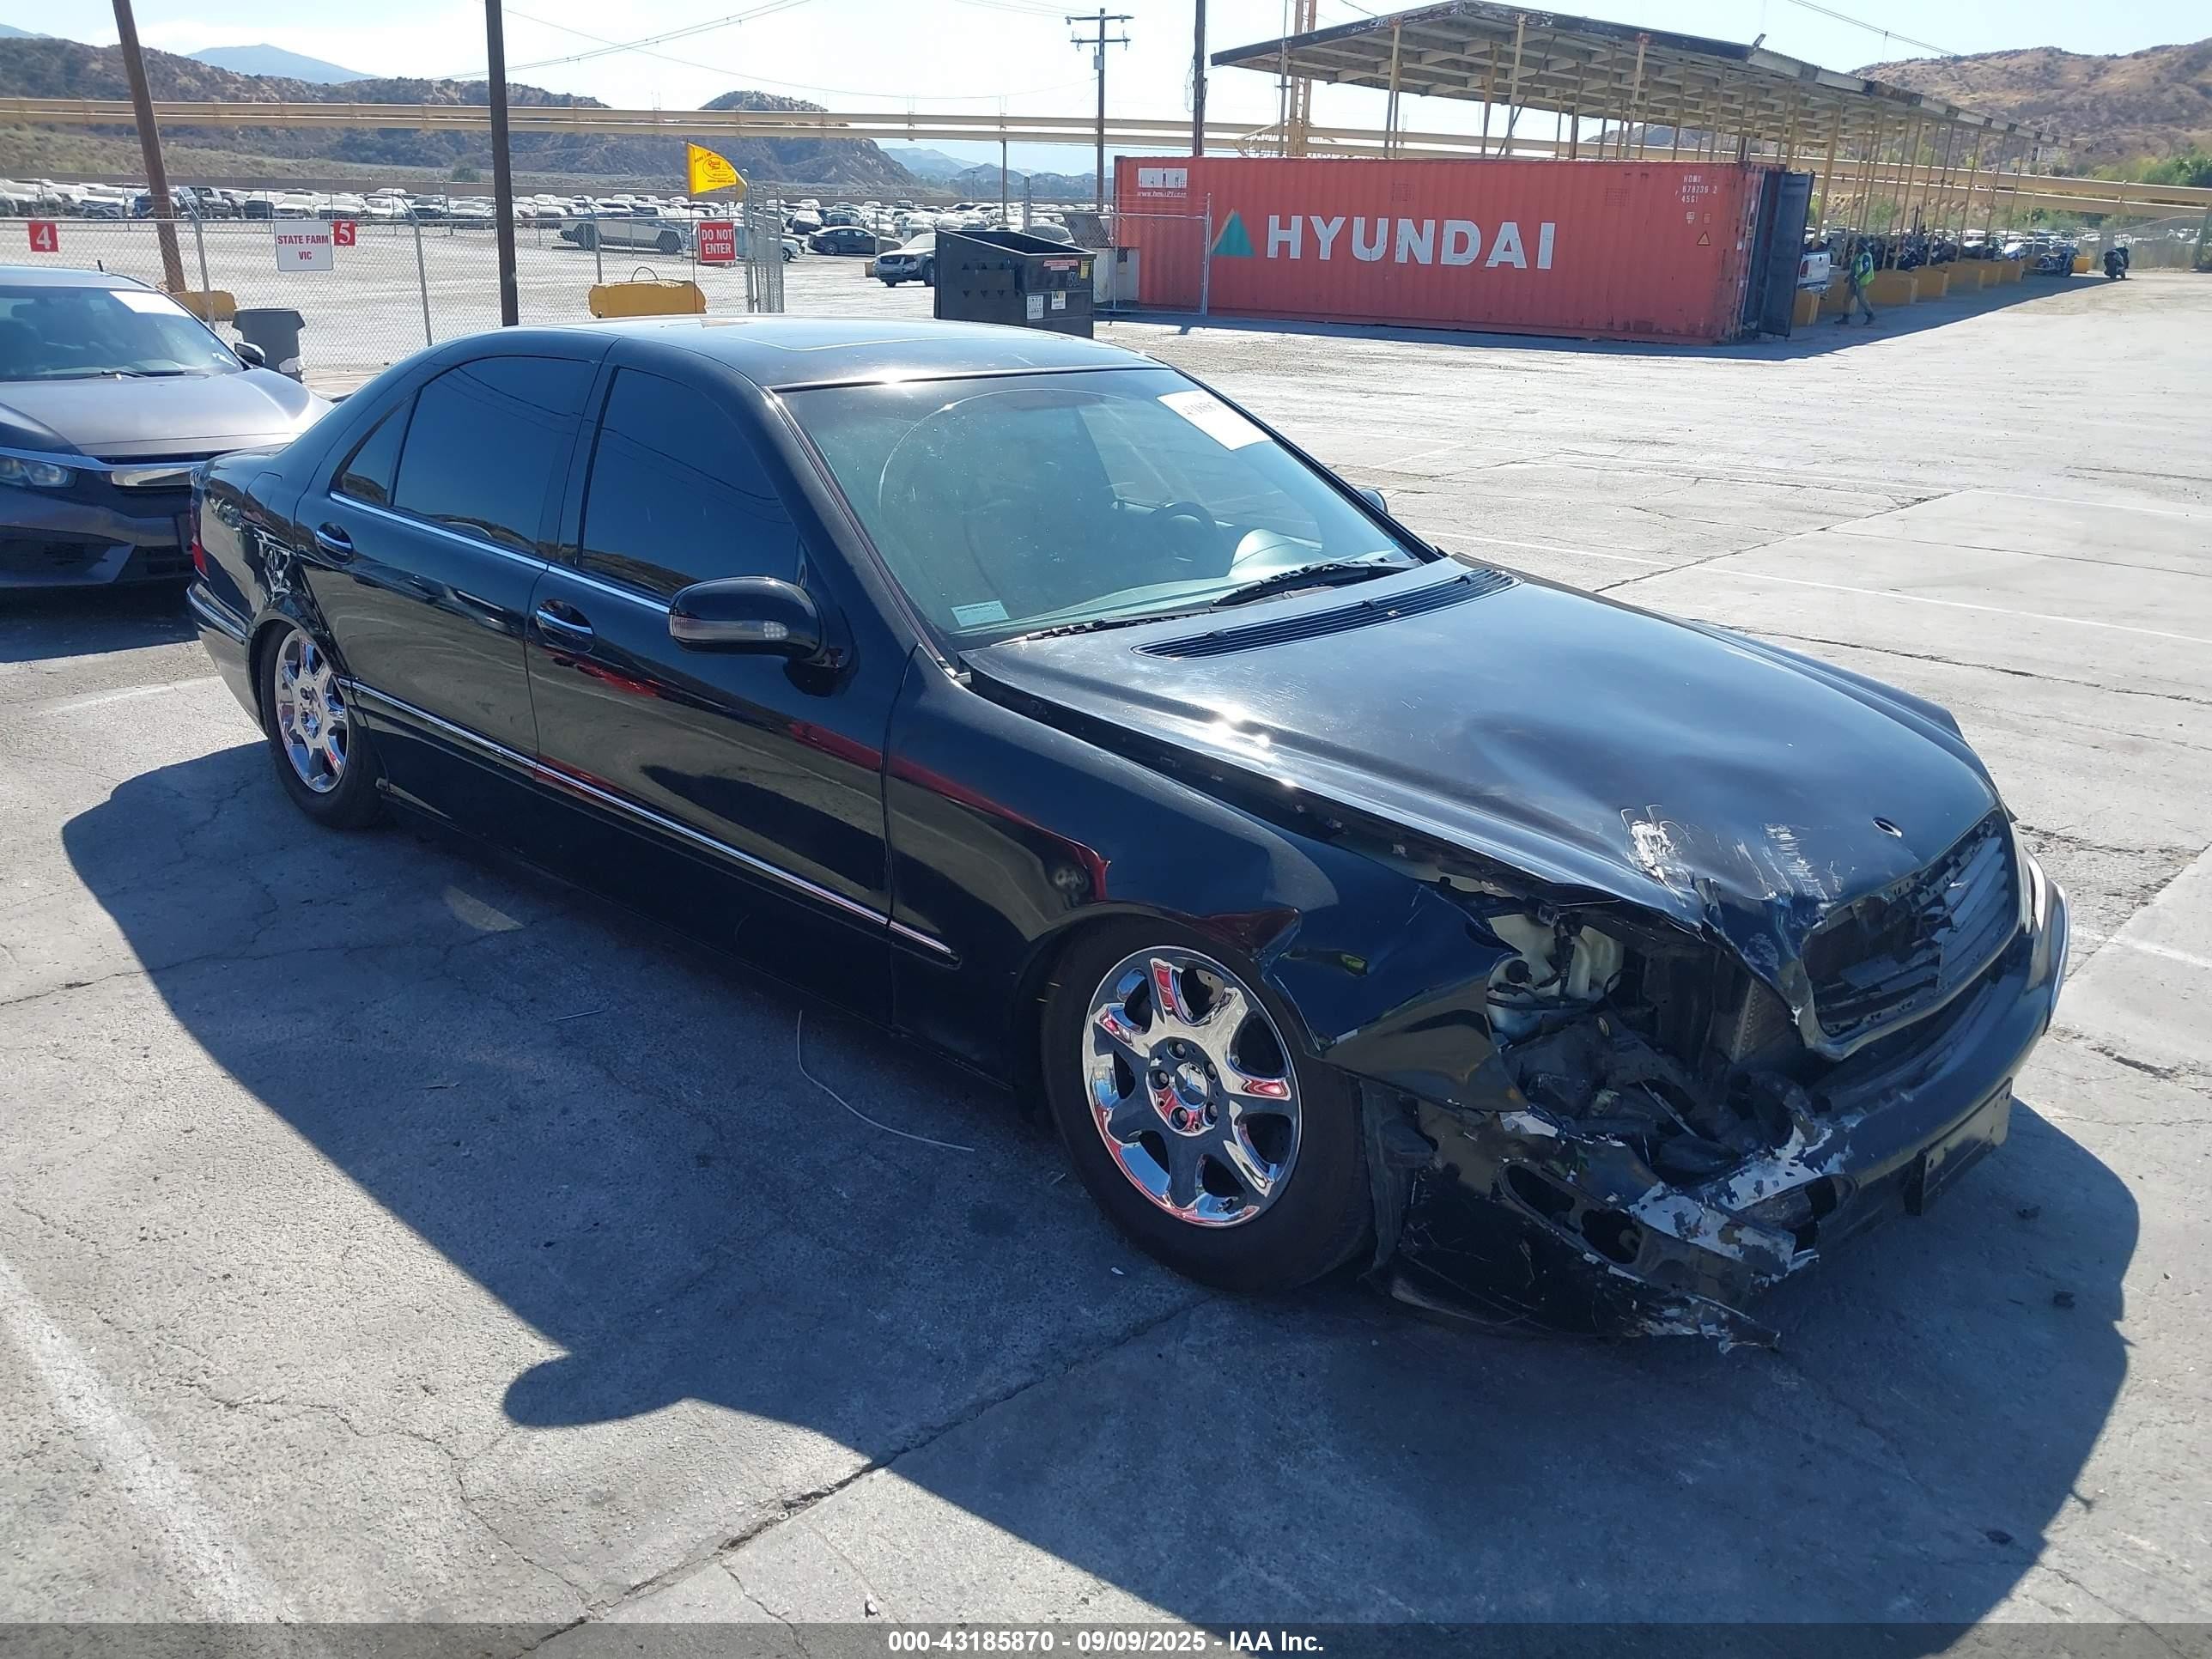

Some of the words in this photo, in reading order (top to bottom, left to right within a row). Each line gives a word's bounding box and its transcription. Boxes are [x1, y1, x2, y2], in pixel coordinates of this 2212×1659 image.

[36, 225, 52, 250] 4
[338, 222, 351, 244] 5
[701, 228, 714, 240] DO
[716, 228, 733, 240] NOT
[277, 234, 304, 245] STATE
[306, 234, 329, 244] FARM
[1267, 215, 1556, 270] HYUNDAI
[705, 243, 732, 255] ENTER
[298, 251, 312, 260] VIC
